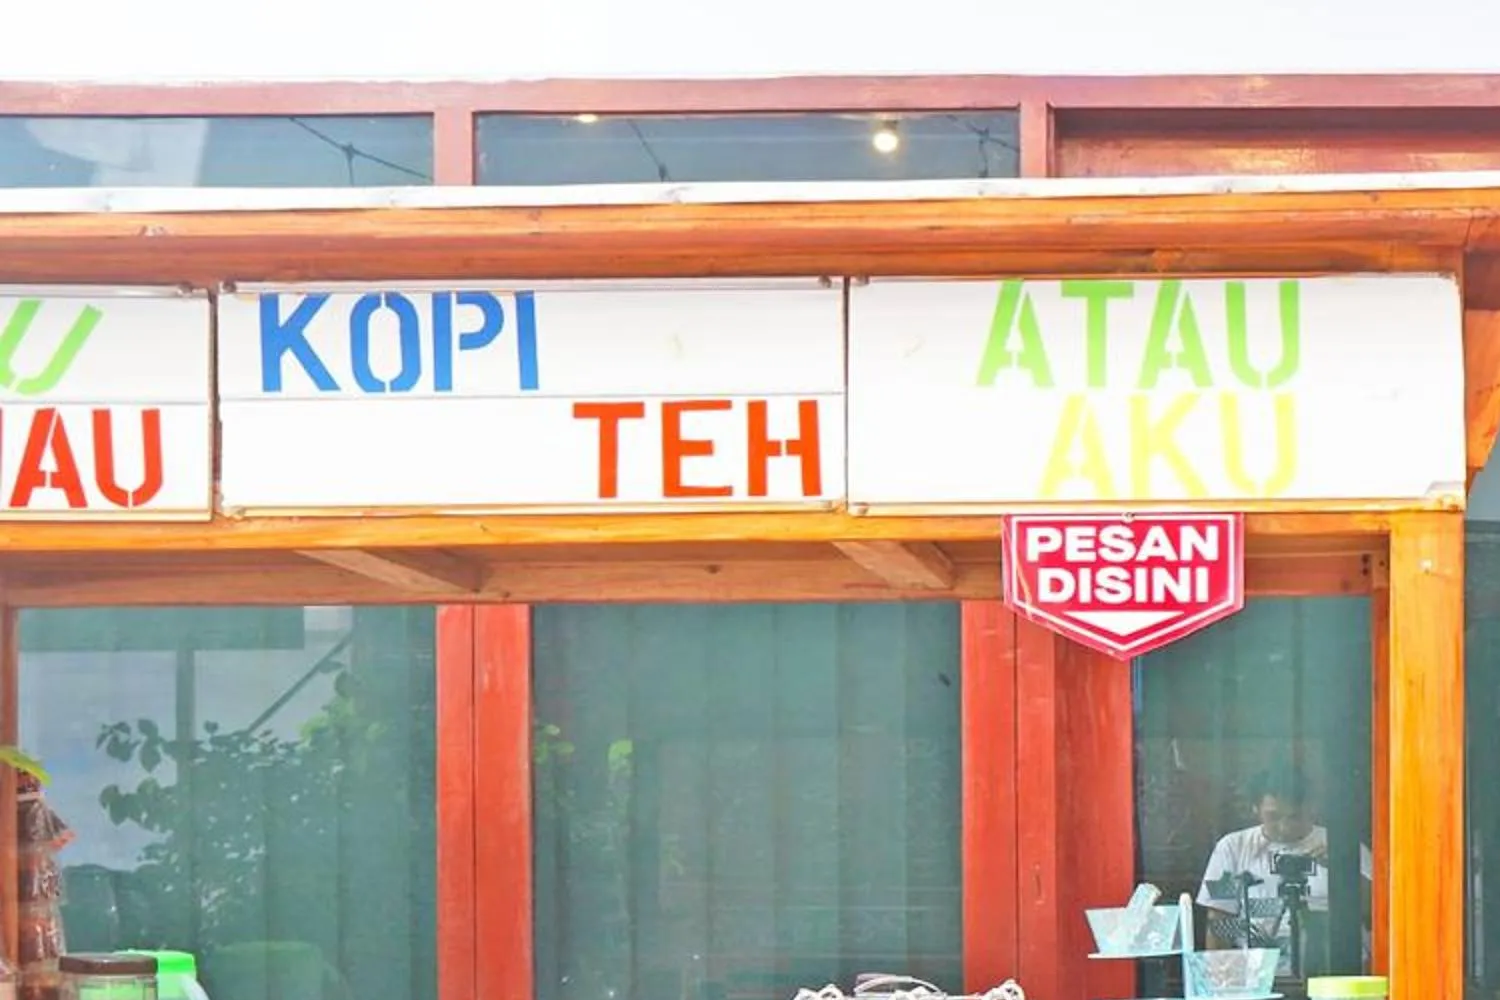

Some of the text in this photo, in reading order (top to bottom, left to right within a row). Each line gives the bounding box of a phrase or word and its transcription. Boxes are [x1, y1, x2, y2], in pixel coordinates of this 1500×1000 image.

[259, 291, 540, 392] KOPI
[976, 278, 1299, 388] ATAU
[0, 408, 163, 508] AU
[573, 399, 822, 498] TEH
[1036, 393, 1298, 499] AKU
[1026, 524, 1219, 563] PESAN
[1038, 566, 1209, 604] DISINI
